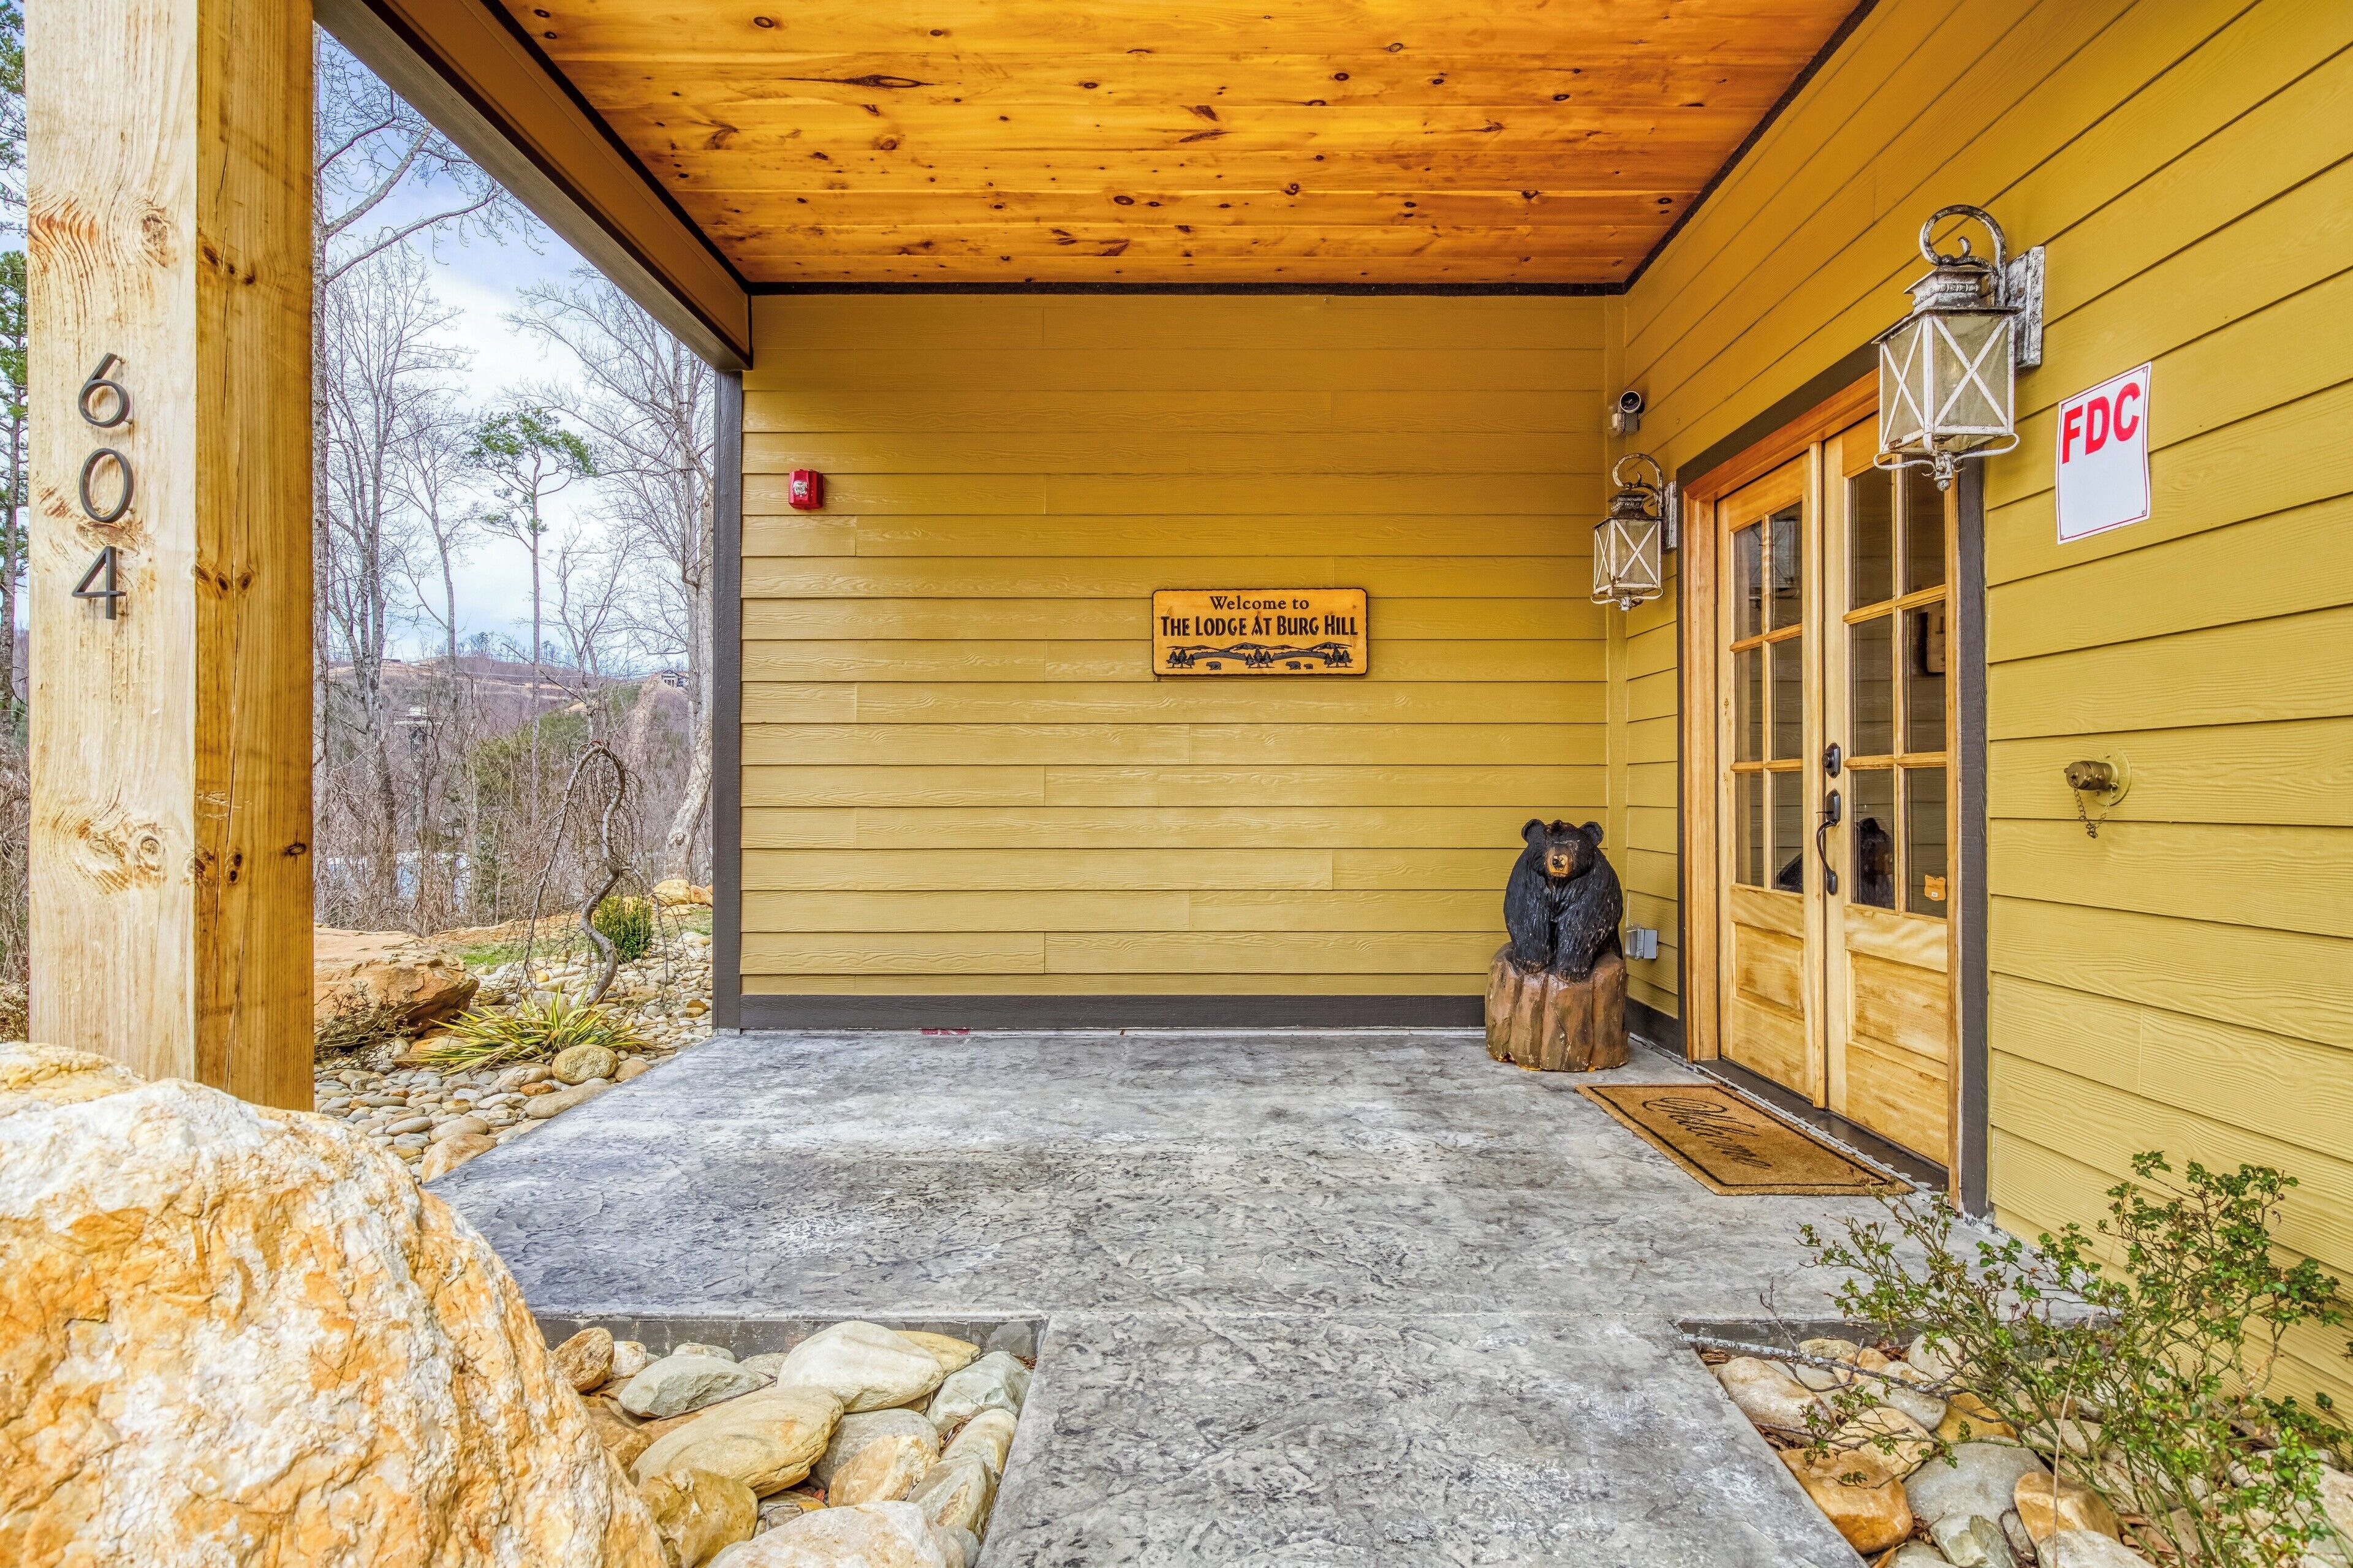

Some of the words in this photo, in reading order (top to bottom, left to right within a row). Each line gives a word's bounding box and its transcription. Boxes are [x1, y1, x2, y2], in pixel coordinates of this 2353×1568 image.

[2061, 382, 2141, 465] FDC
[72, 352, 134, 620] 604
[1161, 616, 1190, 636] THE
[1195, 616, 1248, 636] LODGE
[1251, 615, 1272, 636] AT
[1277, 615, 1319, 636] BURG
[1324, 615, 1358, 636] HILL
[1209, 595, 1287, 610] Welcome
[1292, 599, 1309, 610] to
